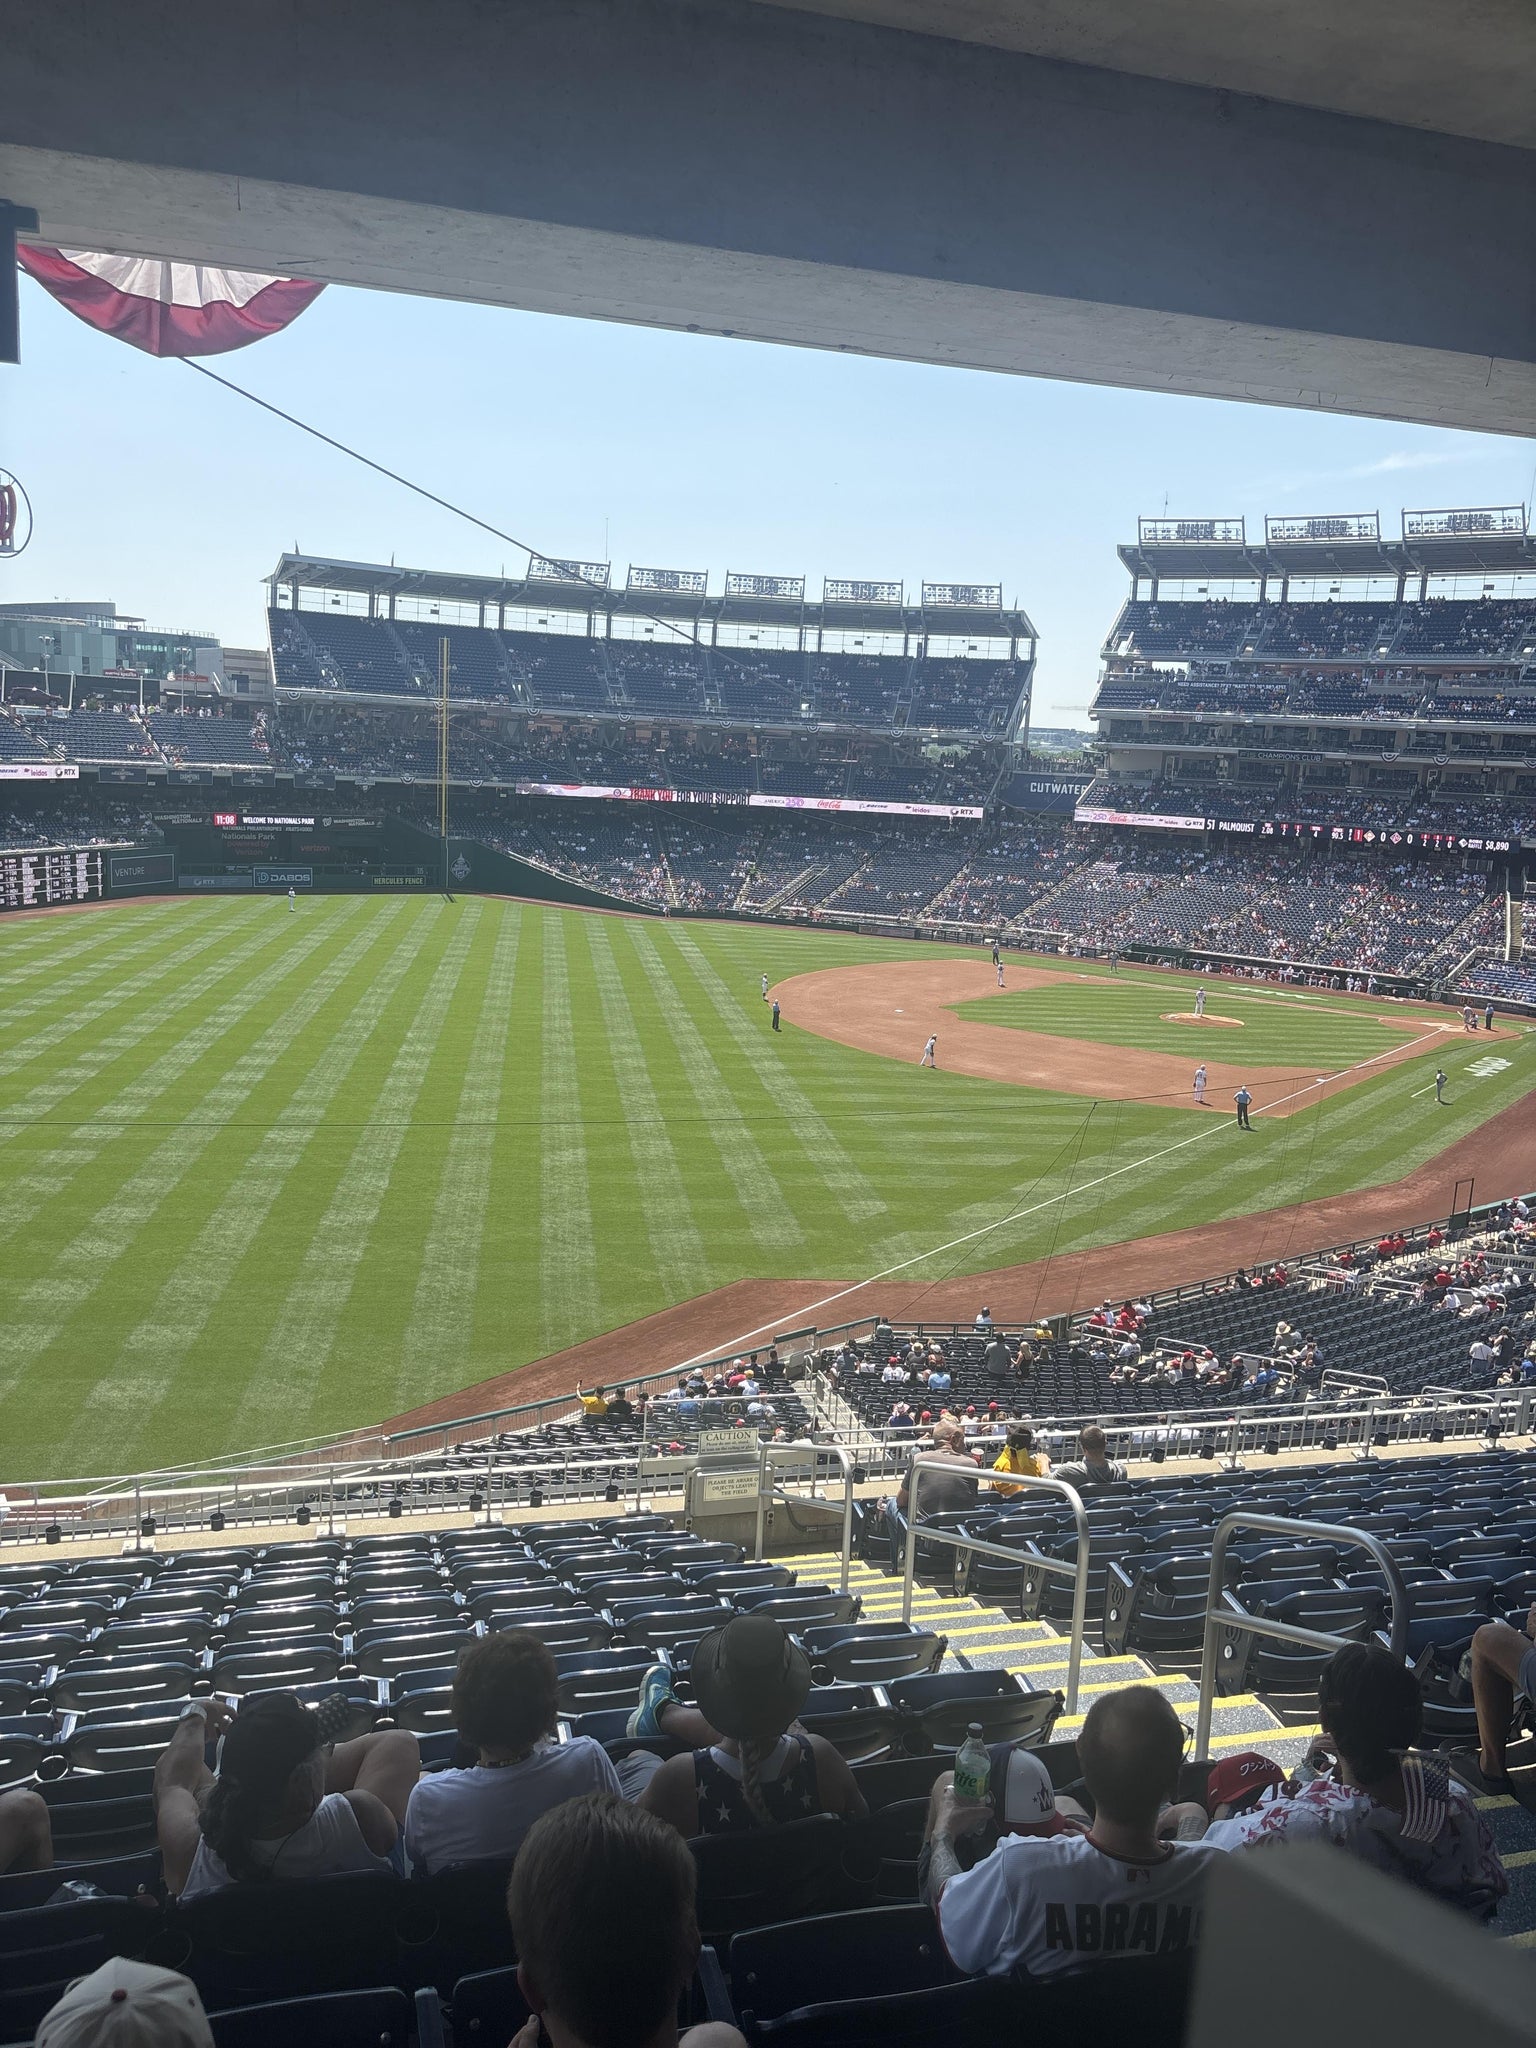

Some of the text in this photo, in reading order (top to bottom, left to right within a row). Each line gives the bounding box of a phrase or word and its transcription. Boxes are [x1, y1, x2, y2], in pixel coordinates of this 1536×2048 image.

[630, 788, 750, 806] THANK YOU FOR YOUR SUPPORT
[216, 815, 235, 825] 11:08
[1206, 819, 1255, 833] 51 PALMQUIST
[1380, 832, 1386, 842] 0
[1406, 834, 1413, 844] 0
[1485, 840, 1510, 851] $8,890
[115, 866, 145, 877] VENTURE
[270, 874, 310, 882] DABOS
[706, 1431, 751, 1442] CAUTION
[954, 1771, 978, 1788] rite
[1046, 1902, 1200, 1951] ABRAM
